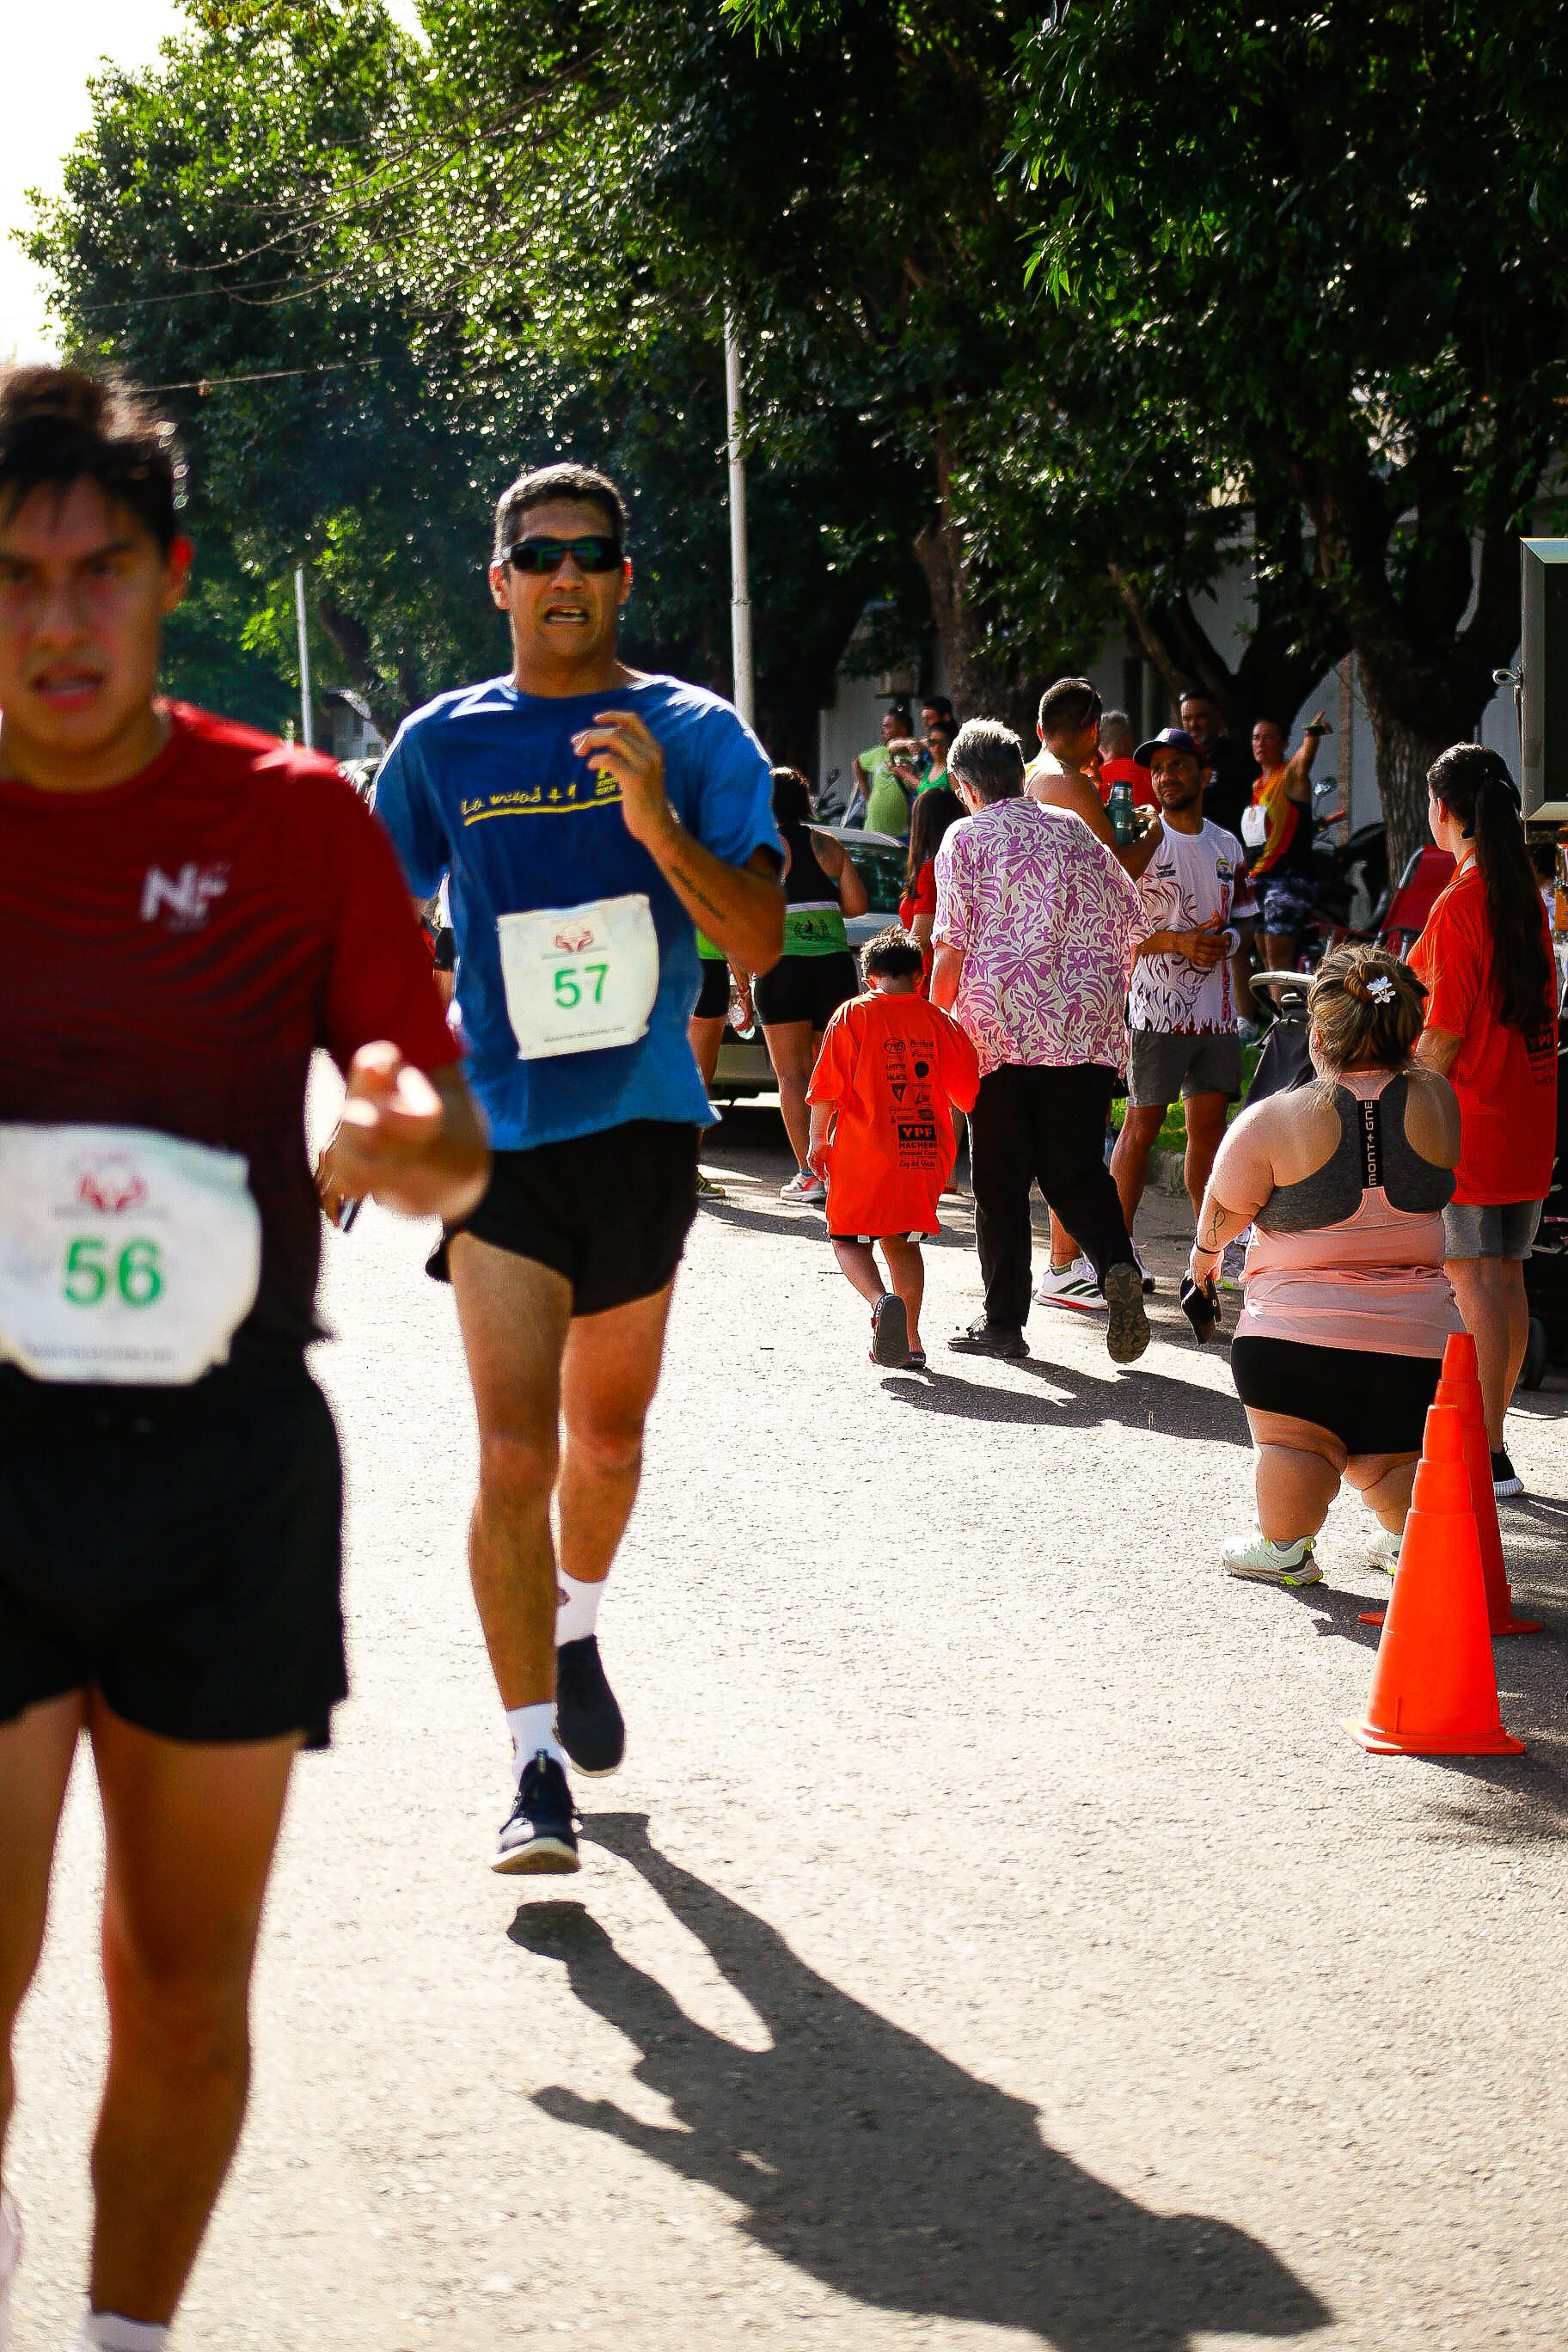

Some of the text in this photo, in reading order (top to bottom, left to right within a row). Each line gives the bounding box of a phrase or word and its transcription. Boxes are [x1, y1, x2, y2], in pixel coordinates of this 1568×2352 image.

[554, 964, 609, 1009] 57
[902, 1127, 933, 1137] YPF
[62, 1234, 165, 1309] 56
